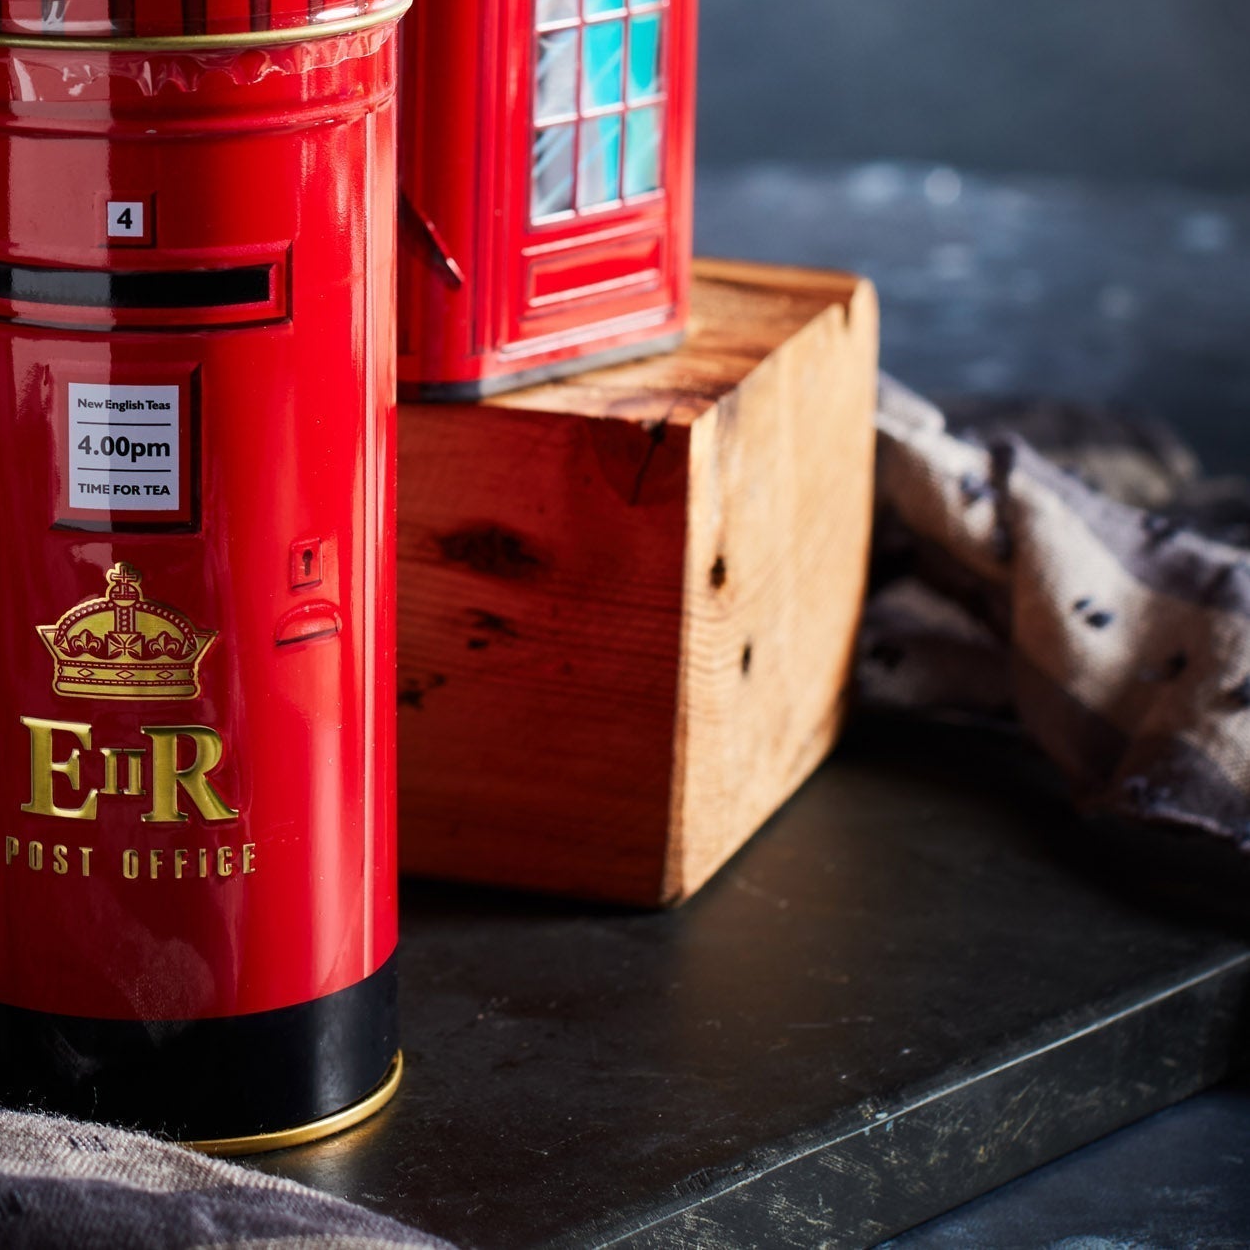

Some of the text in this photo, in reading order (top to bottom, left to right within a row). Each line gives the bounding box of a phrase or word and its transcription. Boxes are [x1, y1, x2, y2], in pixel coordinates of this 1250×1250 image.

[116, 207, 133, 230] 4
[77, 398, 171, 412] New English Teas
[77, 434, 171, 463] 4.00pm
[77, 483, 171, 496] TIME FOR TEA
[5, 835, 256, 880] POST OFFICE
